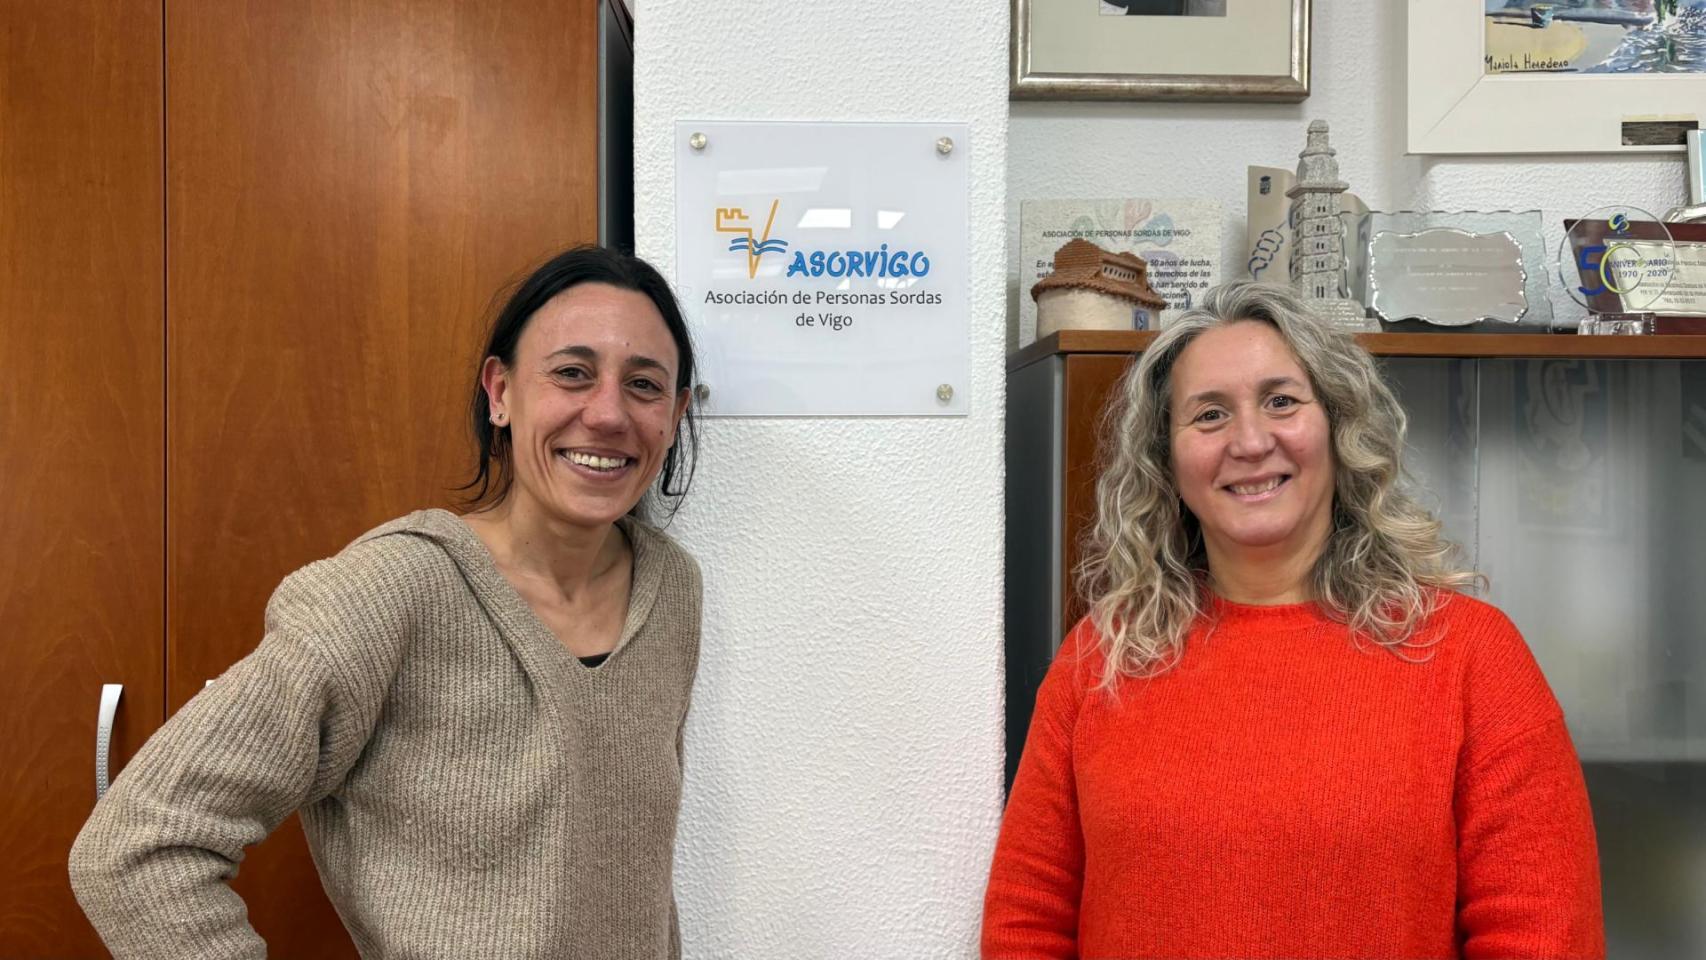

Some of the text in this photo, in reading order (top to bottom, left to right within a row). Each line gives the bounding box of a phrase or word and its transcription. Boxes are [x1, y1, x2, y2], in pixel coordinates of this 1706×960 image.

[1095, 230, 1132, 238] PERSONAS
[1179, 258, 1189, 266] de
[1190, 258, 1212, 268] lucha,
[1154, 269, 1188, 278] derechos
[1189, 269, 1199, 278] de
[1200, 269, 1210, 278] las
[1618, 270, 1638, 278] 1970
[1647, 269, 1668, 277] 2020
[1199, 280, 1209, 288] de
[704, 291, 942, 305] Asociación de Personas Sordas
[795, 313, 853, 330] de Vigo
